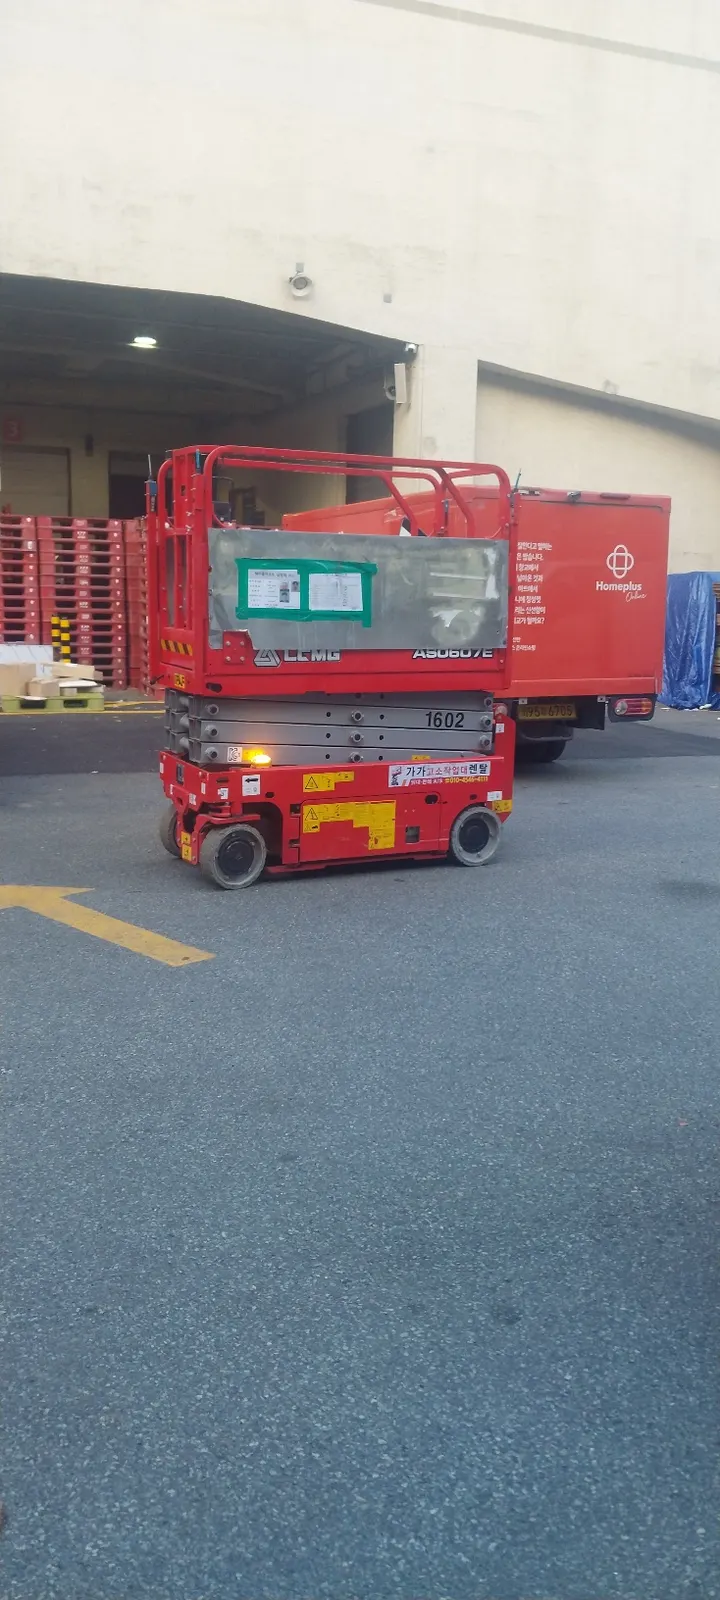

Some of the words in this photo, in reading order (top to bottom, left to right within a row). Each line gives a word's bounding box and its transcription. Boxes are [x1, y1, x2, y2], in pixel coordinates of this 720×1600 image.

[596, 580, 642, 593] Homeplus
[625, 591, 647, 602] Online
[412, 649, 493, 660] AS0607E
[425, 711, 465, 728] 1602
